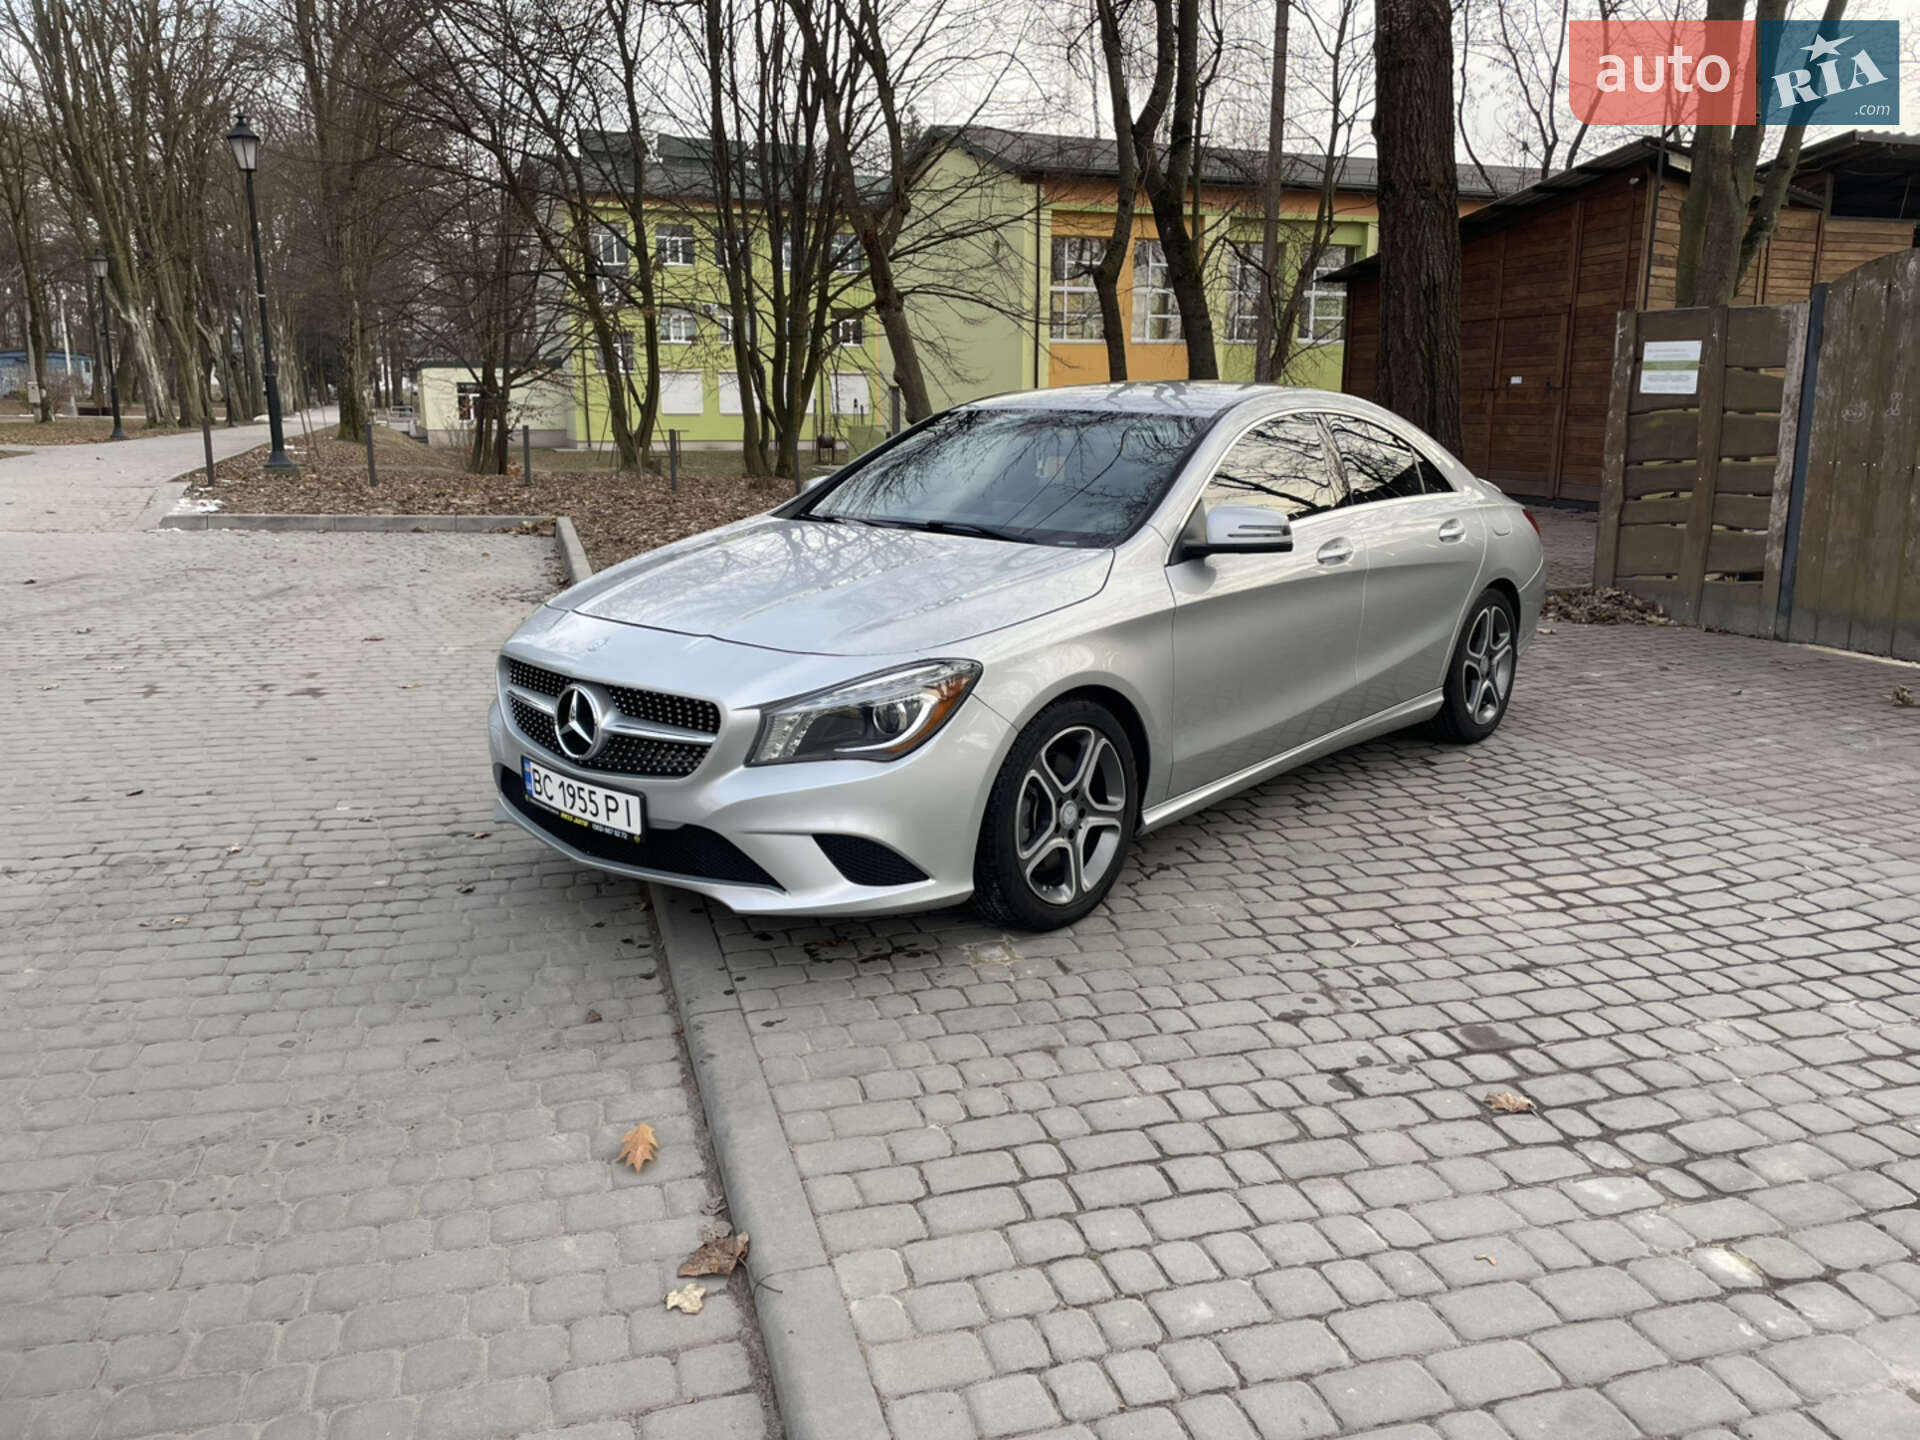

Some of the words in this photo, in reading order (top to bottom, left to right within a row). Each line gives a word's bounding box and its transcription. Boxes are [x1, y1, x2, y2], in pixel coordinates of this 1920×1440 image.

[532, 768, 554, 801] BC
[558, 780, 599, 817] 1955
[604, 794, 631, 827] PI
